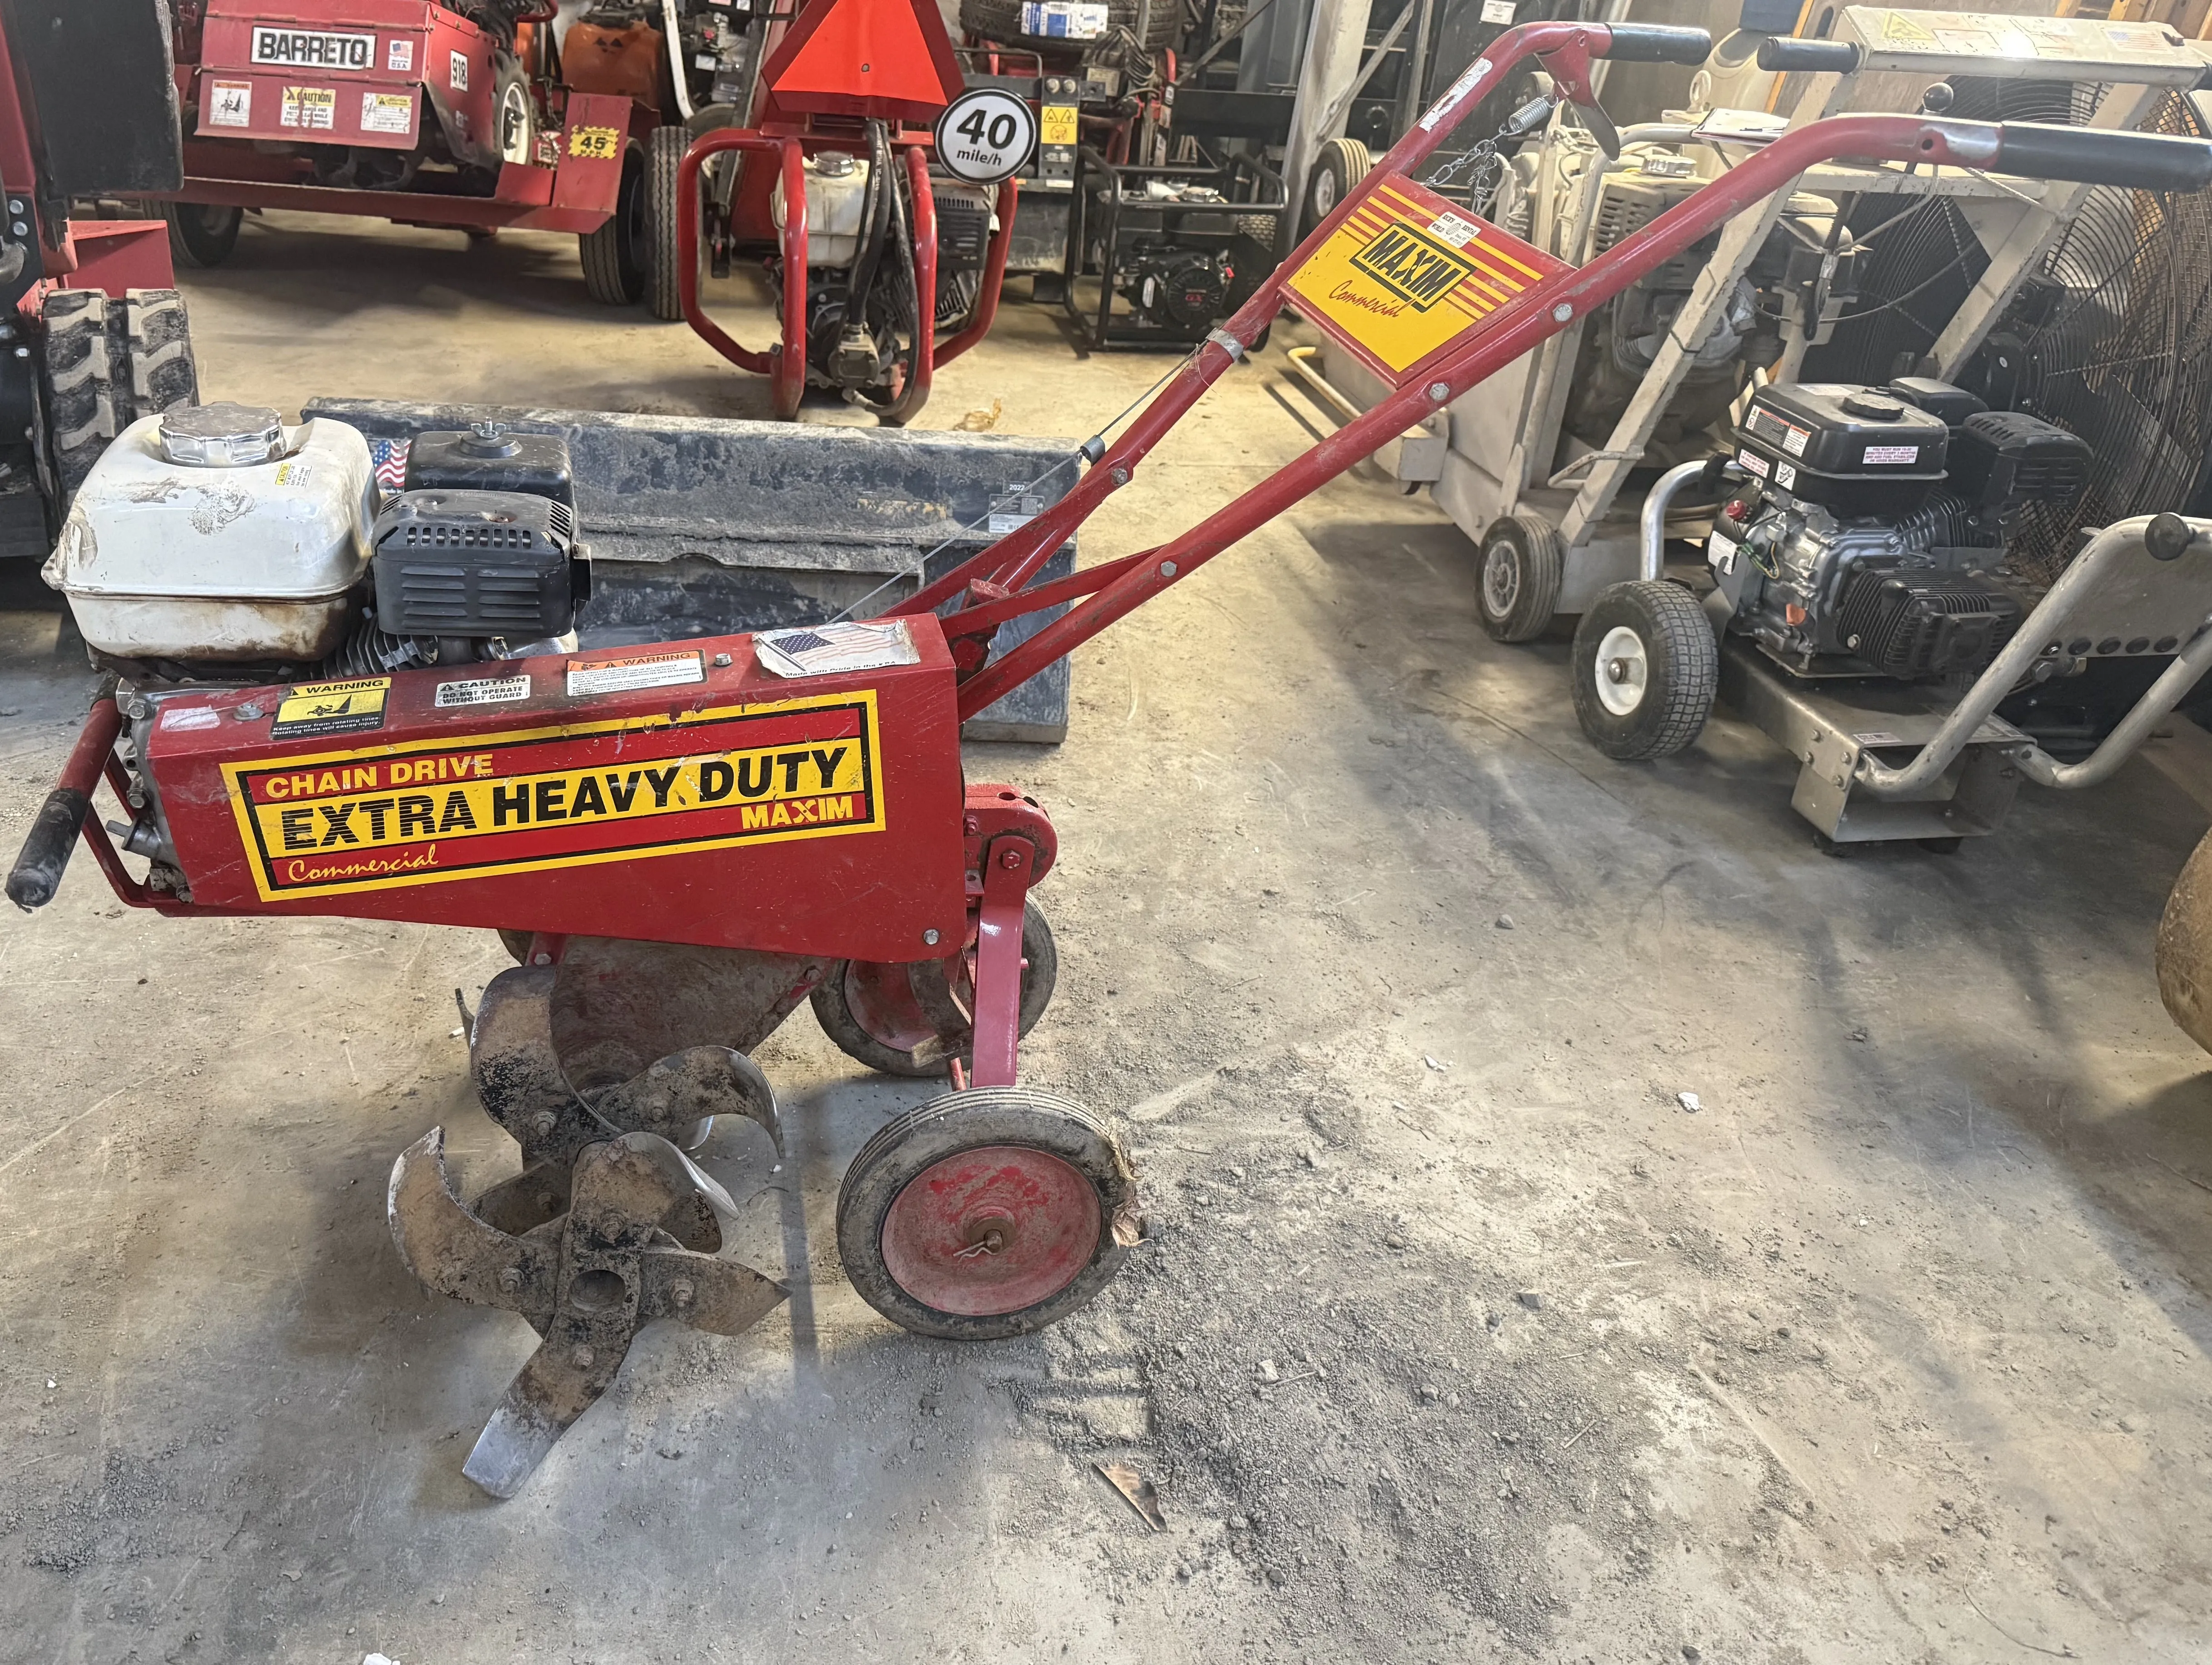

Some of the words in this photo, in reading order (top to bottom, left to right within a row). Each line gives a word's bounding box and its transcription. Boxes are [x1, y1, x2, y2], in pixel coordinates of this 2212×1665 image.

[259, 32, 367, 64] BARRETO
[452, 58, 466, 84] 918
[581, 136, 606, 150] 45
[957, 109, 1016, 149] 40
[957, 149, 1002, 166] mile/h
[1362, 229, 1462, 302] MAXIM
[1329, 279, 1416, 318] Commercial
[623, 653, 691, 665] WARNING
[306, 680, 384, 694] WARNING
[459, 677, 526, 689] CAUTION
[482, 686, 523, 694] OPERATE
[443, 695, 486, 704] WITHOUT
[266, 766, 377, 798] CHAIN
[390, 754, 493, 784] DRIVE
[281, 791, 477, 851] EXTRA
[492, 766, 682, 827] HEAVY
[699, 747, 848, 803] DUTY
[741, 796, 854, 829] MAXIM
[288, 843, 439, 882] Commercial
